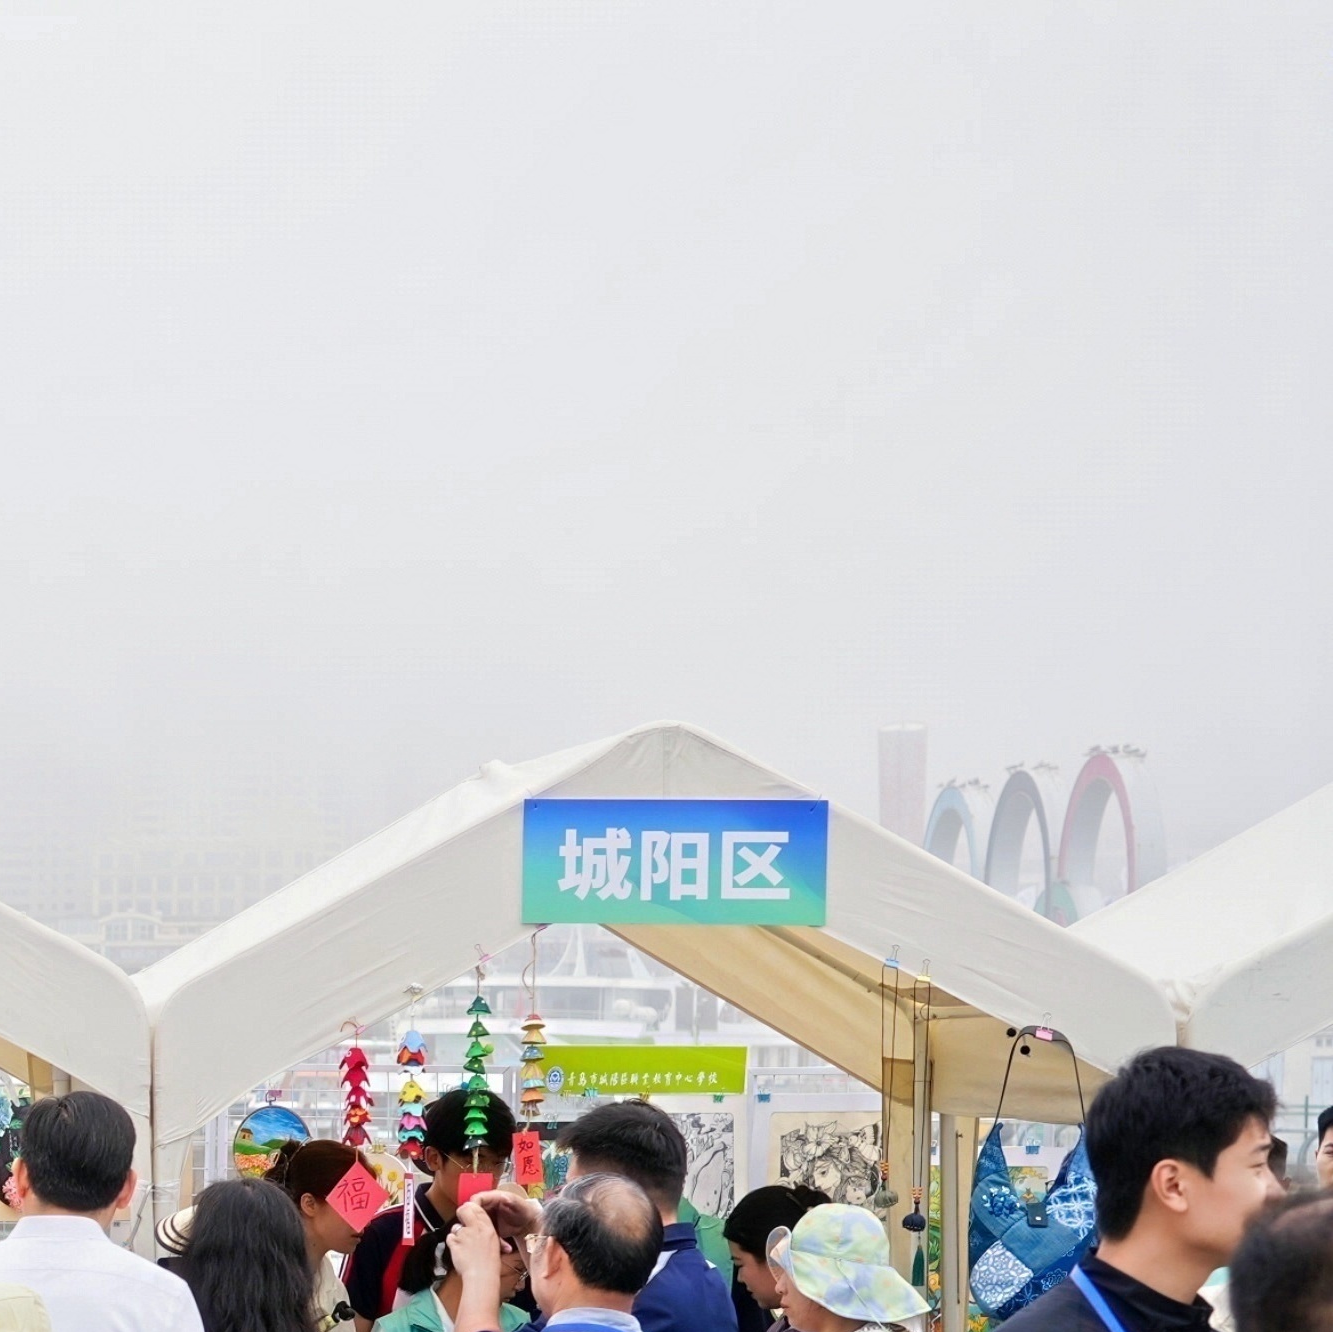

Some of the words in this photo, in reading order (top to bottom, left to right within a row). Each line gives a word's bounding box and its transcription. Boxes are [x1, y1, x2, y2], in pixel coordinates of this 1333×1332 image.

[558, 826, 791, 901] 城阳区
[518, 1138, 539, 1176] 如愿
[337, 1177, 370, 1213] 福
